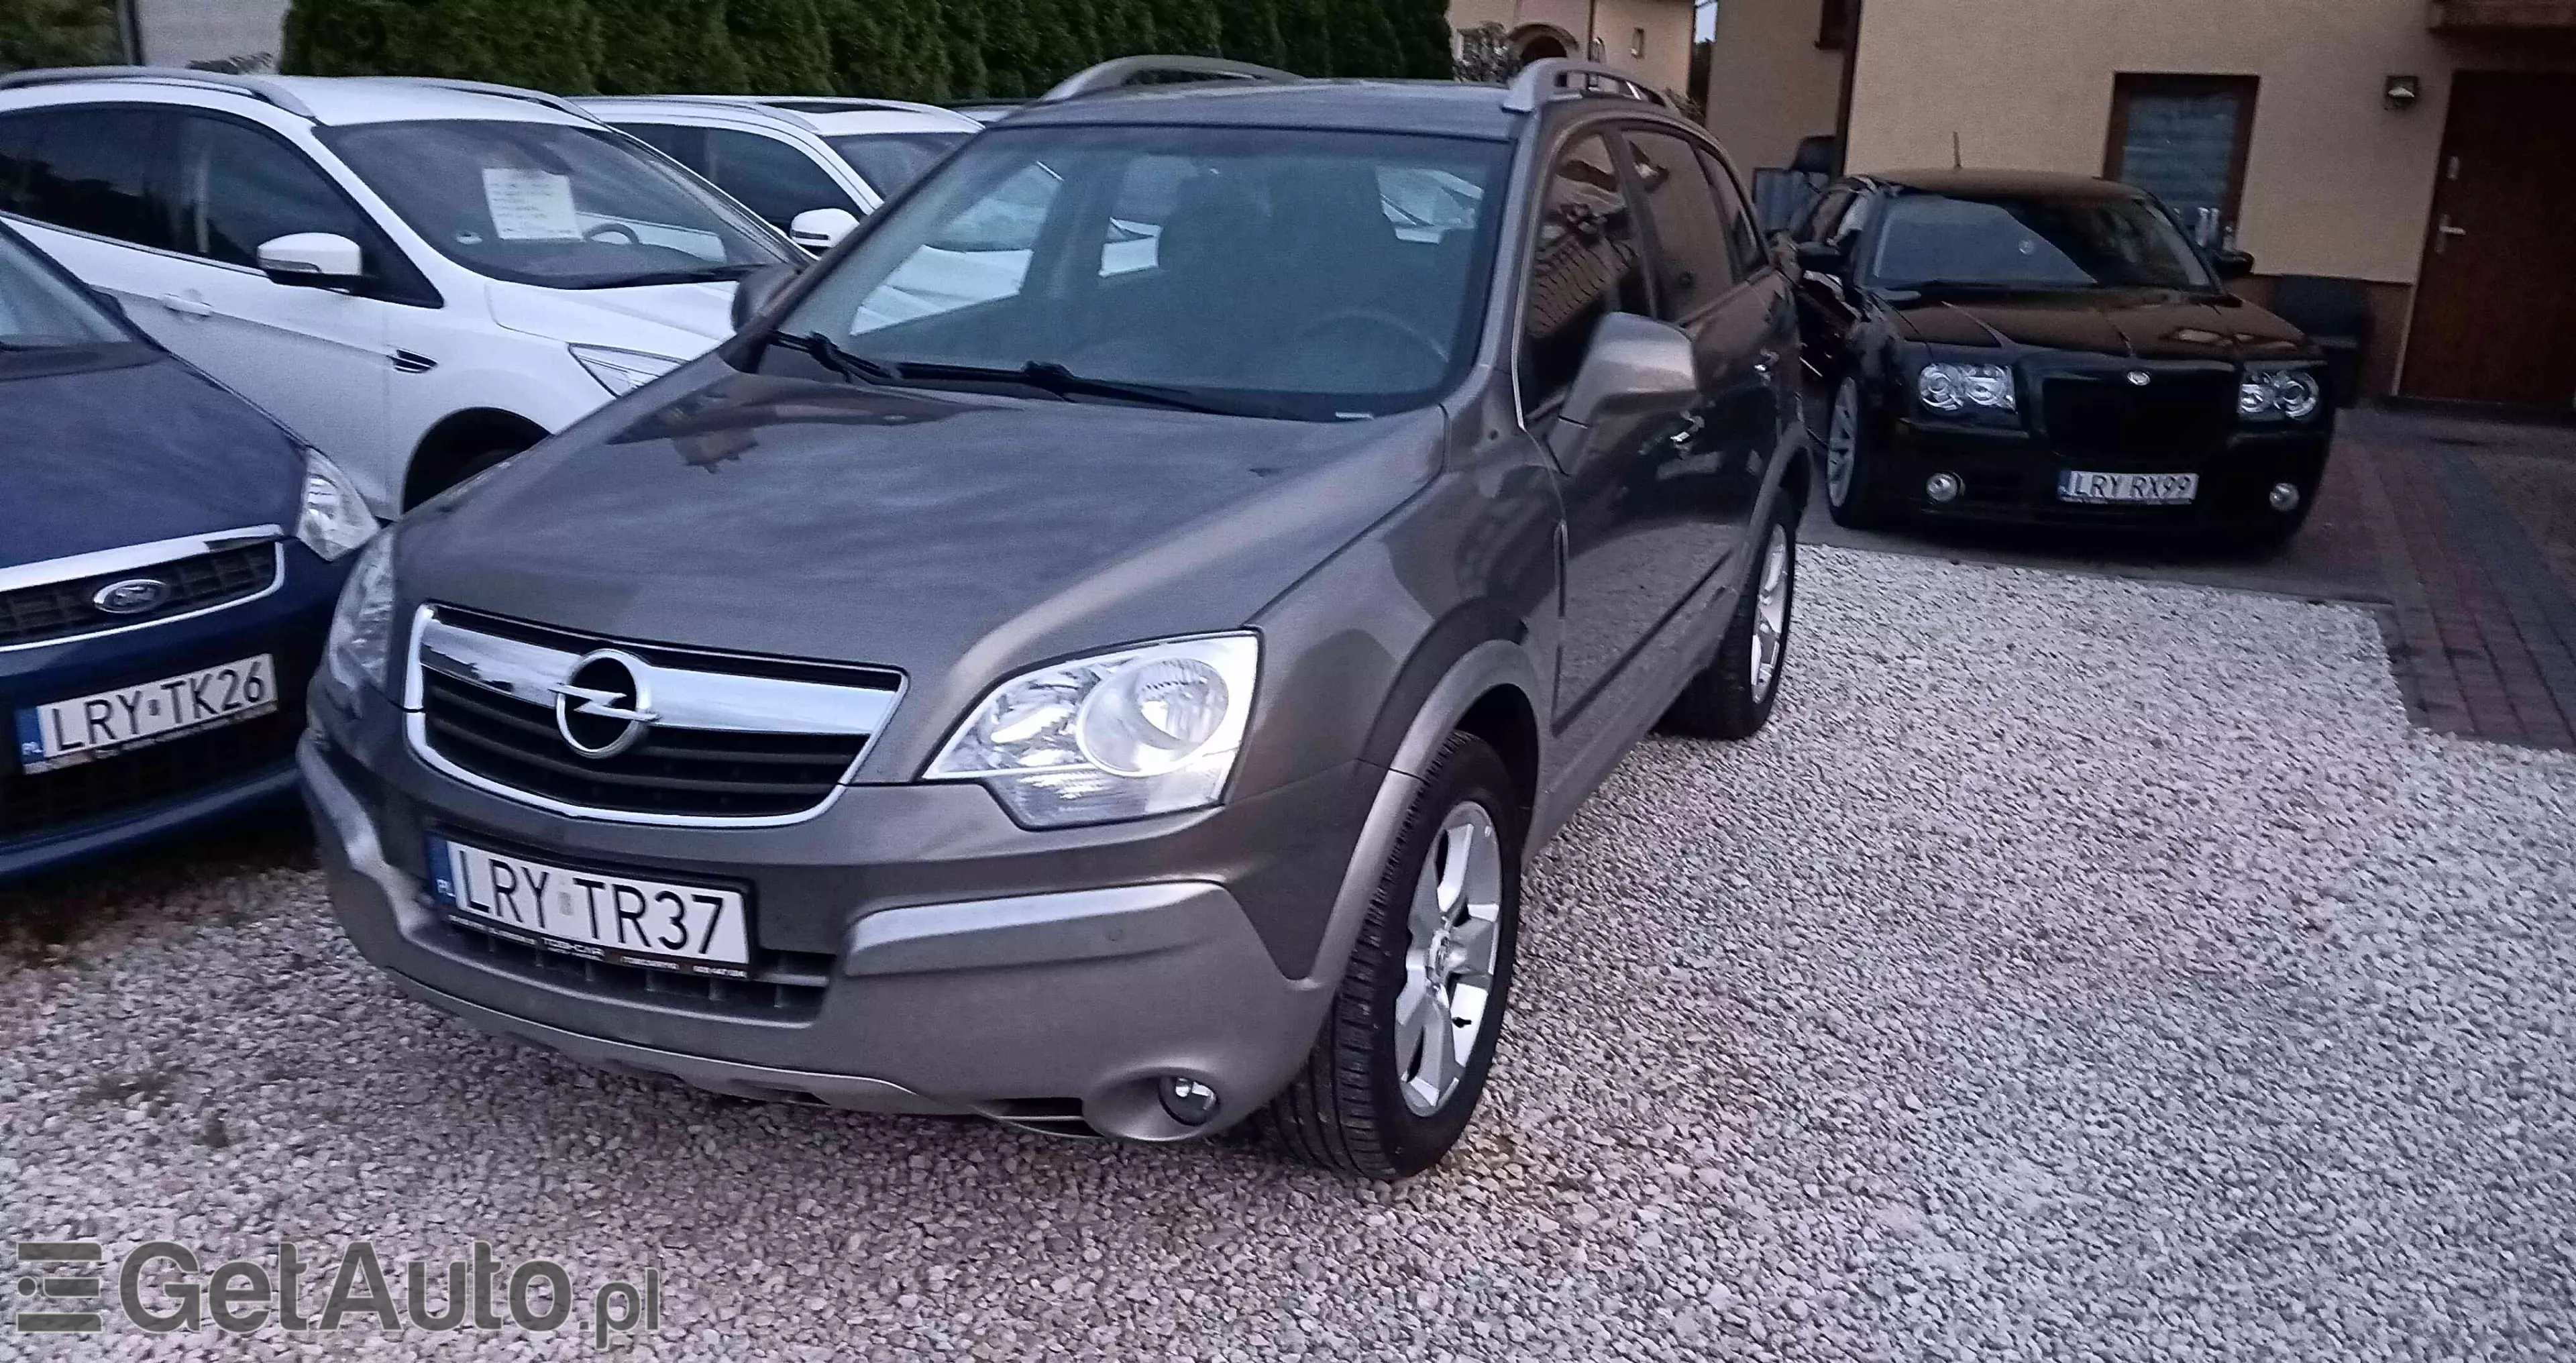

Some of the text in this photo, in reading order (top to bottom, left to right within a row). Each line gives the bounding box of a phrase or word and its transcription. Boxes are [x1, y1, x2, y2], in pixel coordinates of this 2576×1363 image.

[2076, 474, 2123, 498] LRY
[2129, 475, 2192, 498] RX99
[52, 661, 264, 752] LRY TK26
[460, 850, 724, 955] LRY TR37
